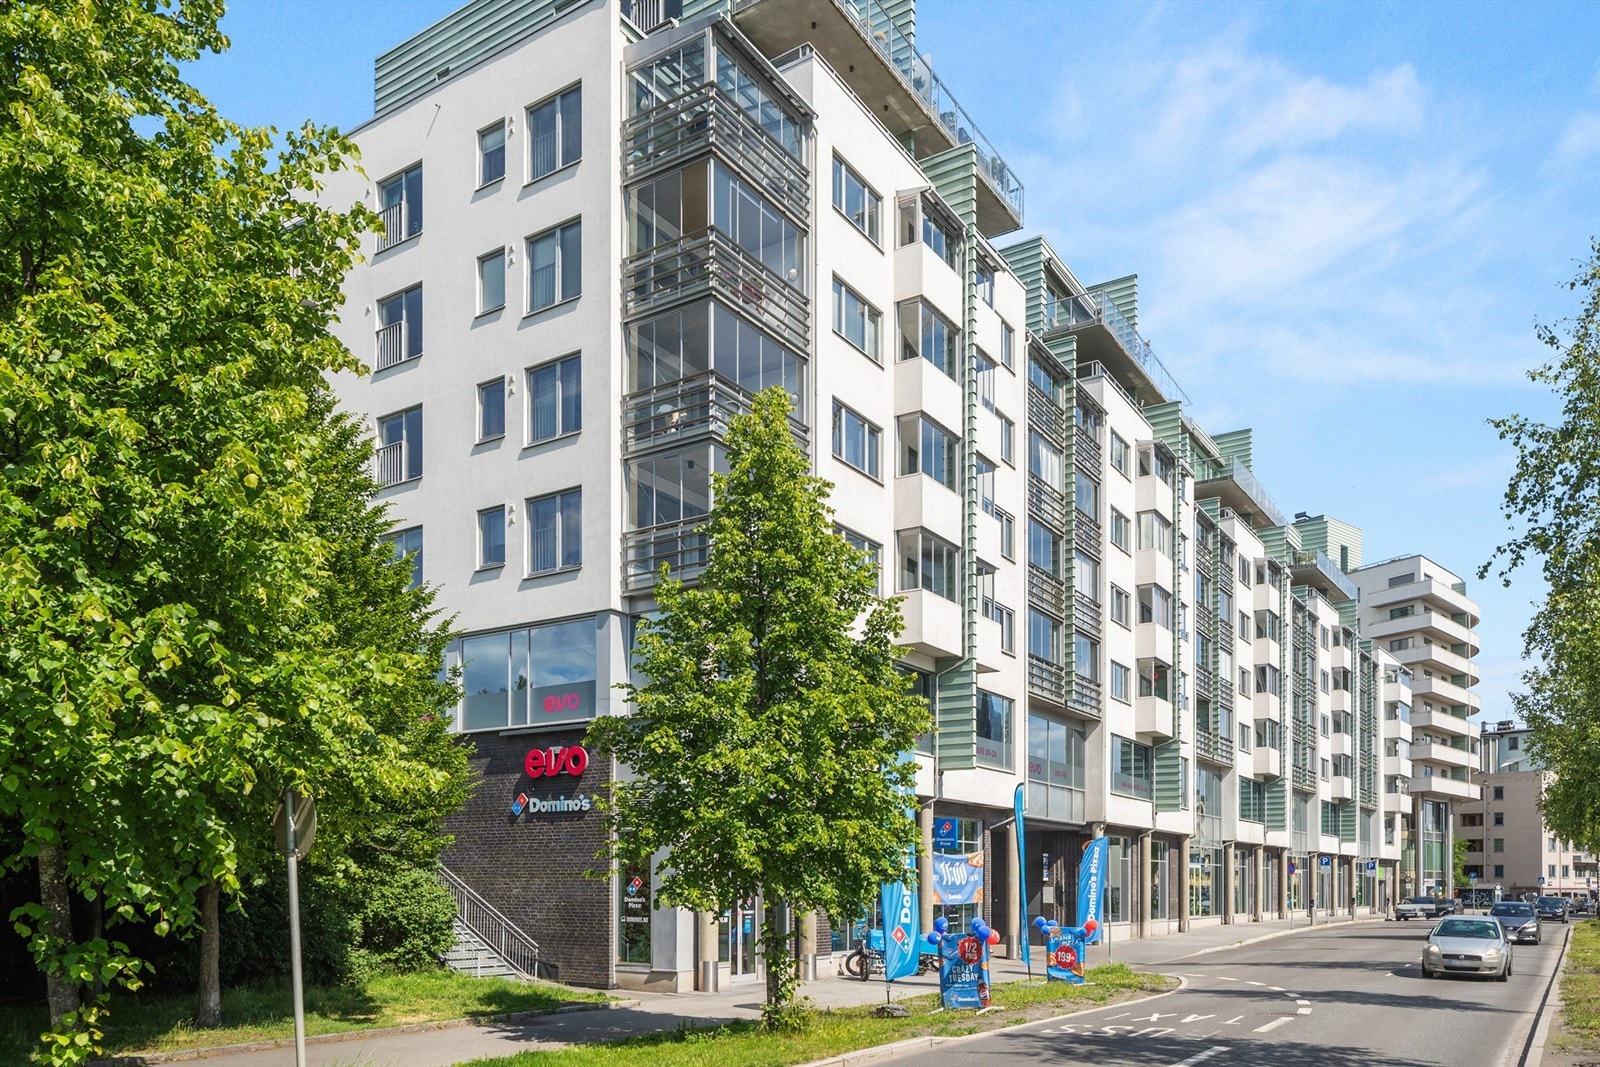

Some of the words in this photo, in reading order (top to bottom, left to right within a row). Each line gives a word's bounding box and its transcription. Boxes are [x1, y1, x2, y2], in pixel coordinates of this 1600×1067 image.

[544, 692, 580, 713] evo
[525, 746, 589, 778] evo
[1028, 762, 1041, 775] evo
[529, 794, 591, 812] Domino's
[1090, 846, 1100, 873] Pizza
[940, 861, 967, 886] 11:00
[1087, 876, 1097, 921] Domino's
[964, 942, 977, 953] 1/2
[949, 973, 979, 983] TUESDAY
[952, 964, 974, 974] CRAZY
[1104, 1013, 1244, 1025] TAXI
